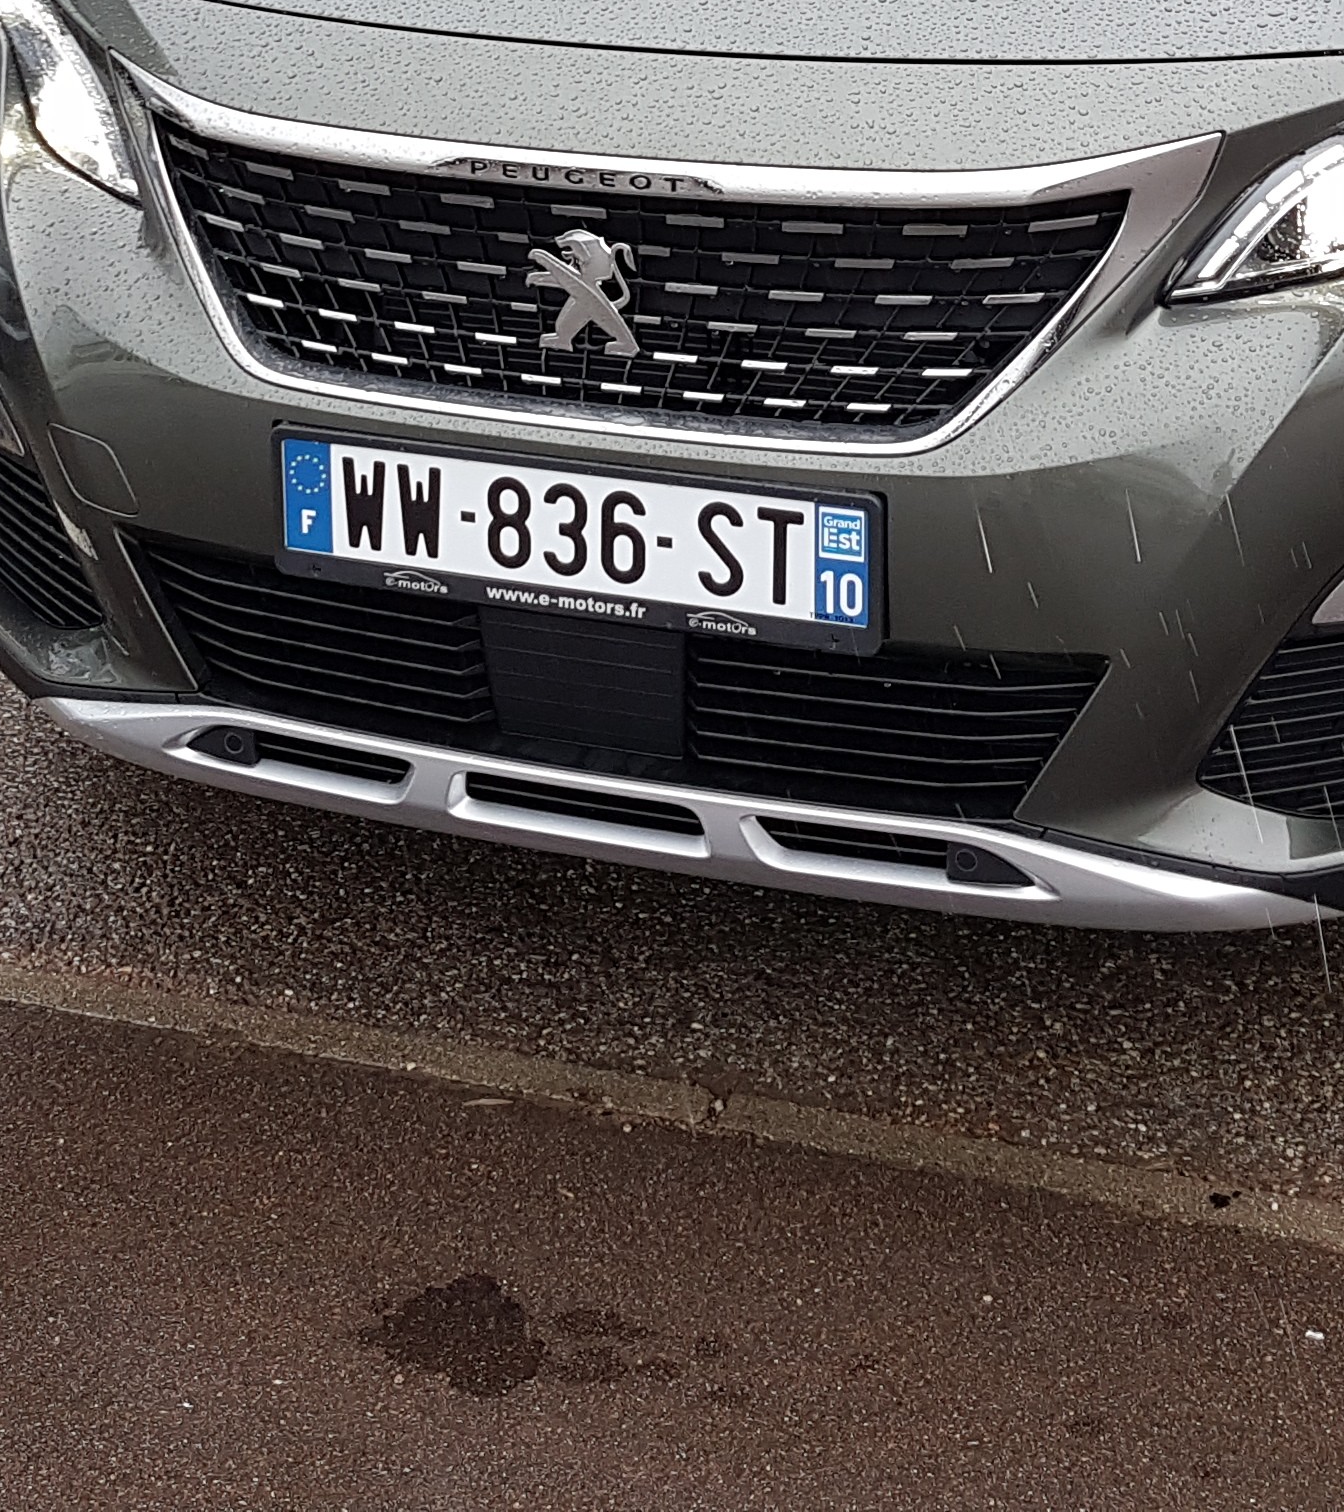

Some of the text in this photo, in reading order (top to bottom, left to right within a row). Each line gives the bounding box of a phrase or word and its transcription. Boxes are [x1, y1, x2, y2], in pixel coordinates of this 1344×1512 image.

[470, 161, 684, 192] PEUGEOT
[301, 509, 317, 534] F
[823, 515, 861, 530] Grand
[823, 527, 860, 551] Est
[485, 586, 647, 619] www.e-motors.fr
[820, 570, 863, 617] 10
